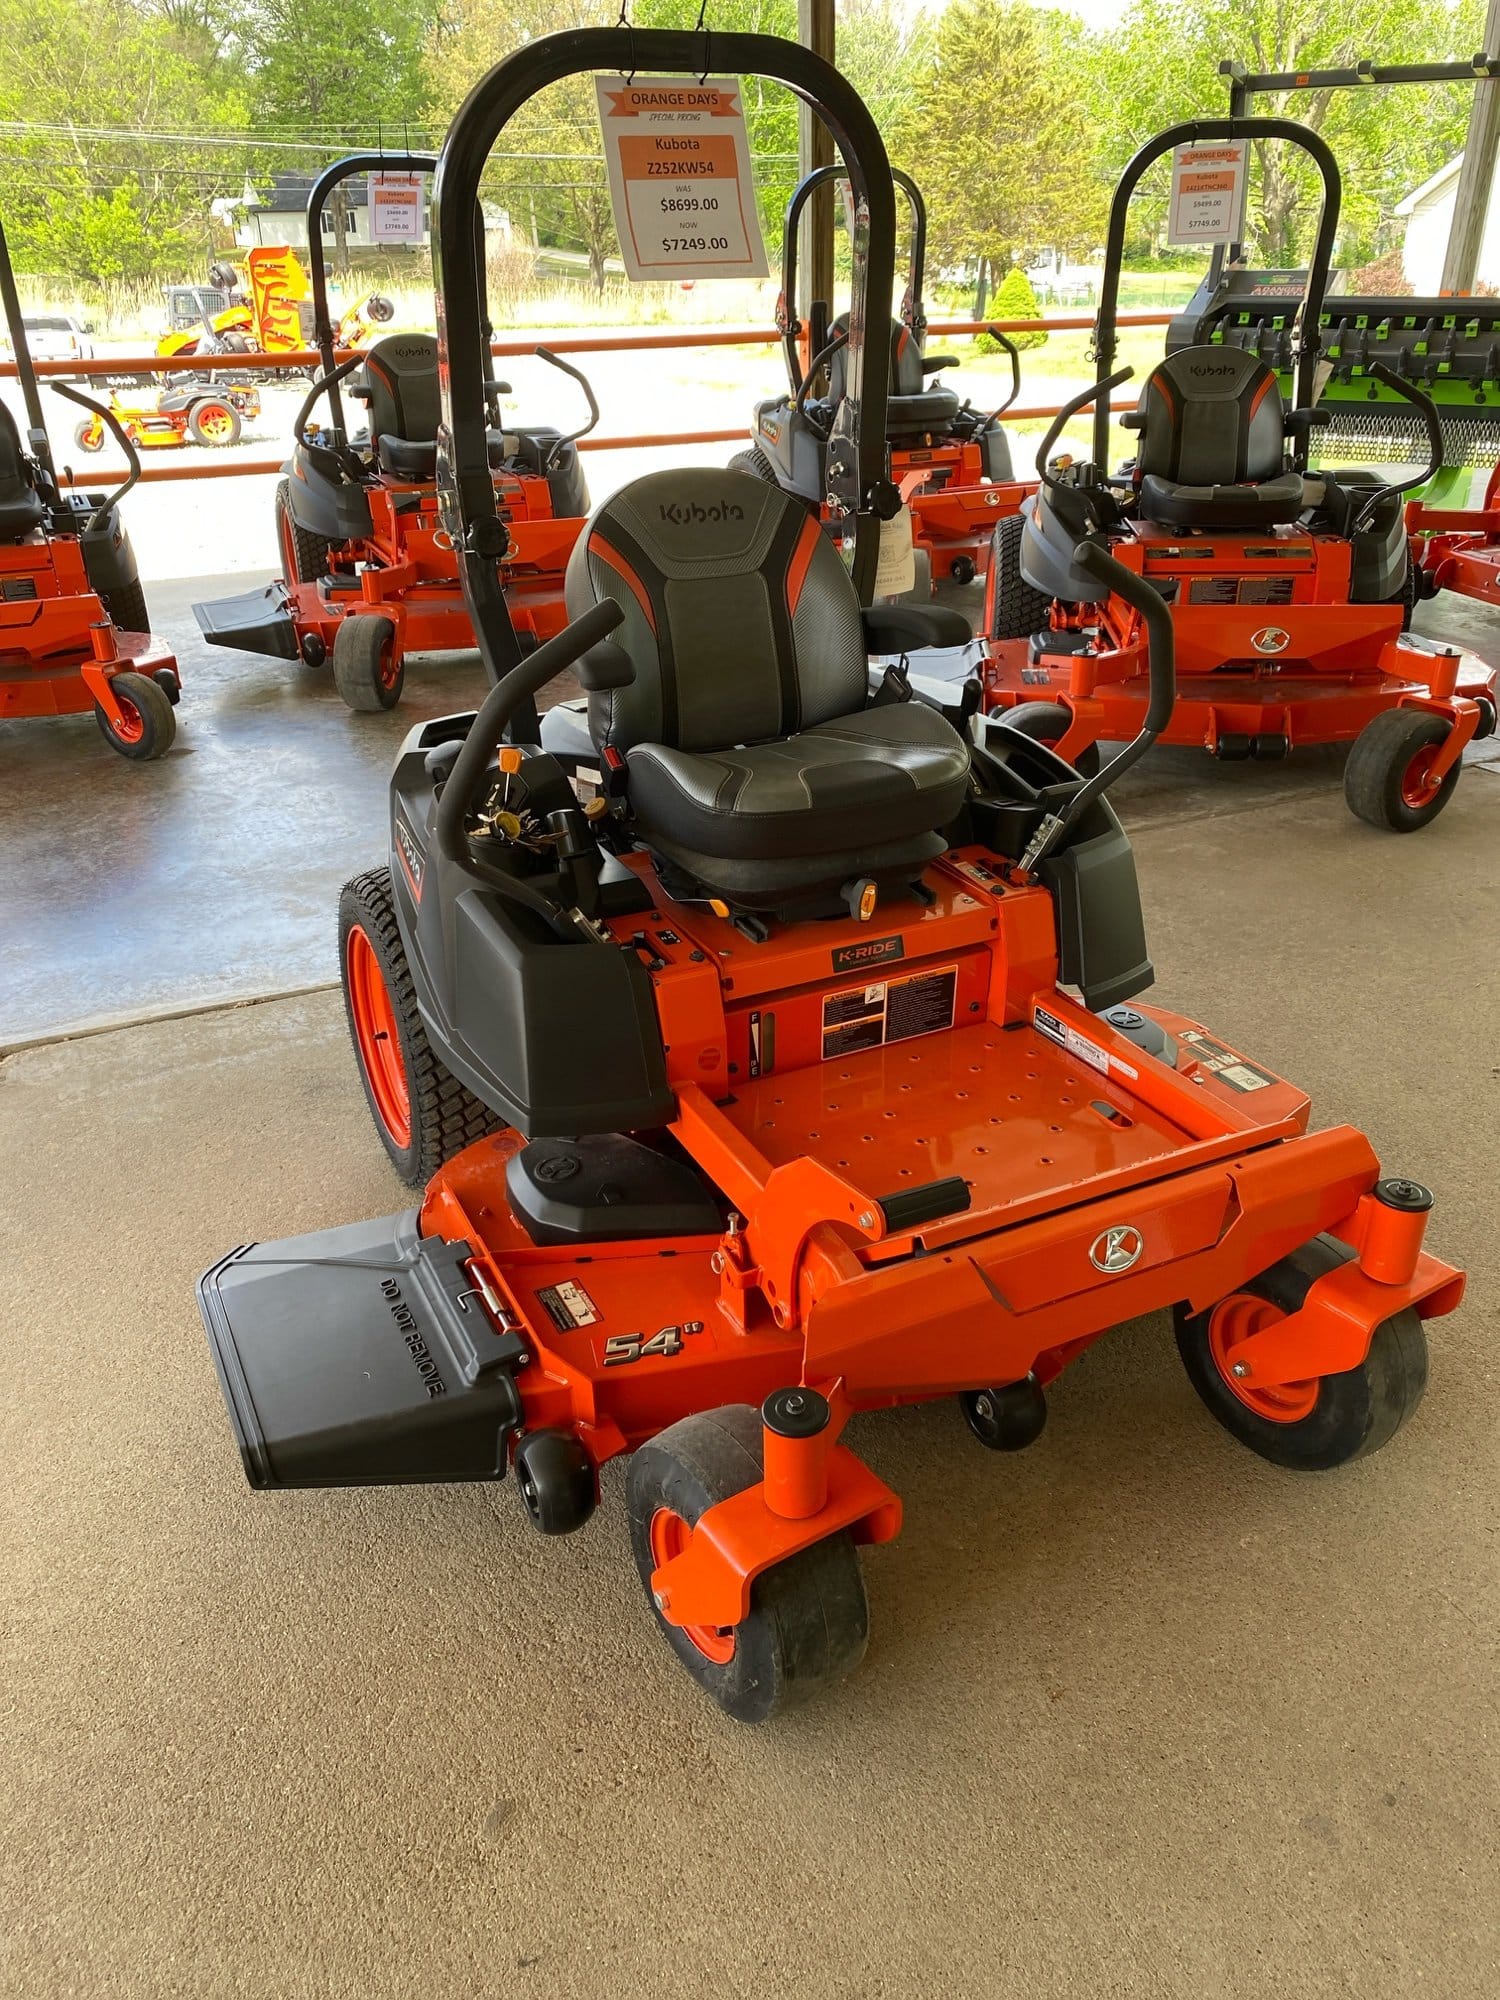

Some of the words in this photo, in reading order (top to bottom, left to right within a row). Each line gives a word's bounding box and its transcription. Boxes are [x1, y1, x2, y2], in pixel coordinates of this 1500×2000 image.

[631, 93, 685, 105] ORANGE
[687, 93, 719, 105] DAYS
[649, 112, 675, 121] SPECIAL
[677, 112, 701, 121] PRICING
[655, 138, 700, 150] Kubota
[647, 161, 715, 175] Z252KW54
[675, 185, 692, 193] WAS
[660, 197, 719, 212] $8699.00
[679, 221, 698, 230] NOW
[1188, 219, 1221, 228] $7749.00
[662, 237, 729, 253] $7249.00
[1190, 364, 1236, 377] Kubota
[658, 499, 745, 526] Kubota
[839, 940, 897, 962] K-RIDE
[380, 1278, 400, 1299] DO
[391, 1302, 417, 1331] NOT
[404, 1332, 446, 1398] REMOVE
[603, 1322, 704, 1367] 54"
